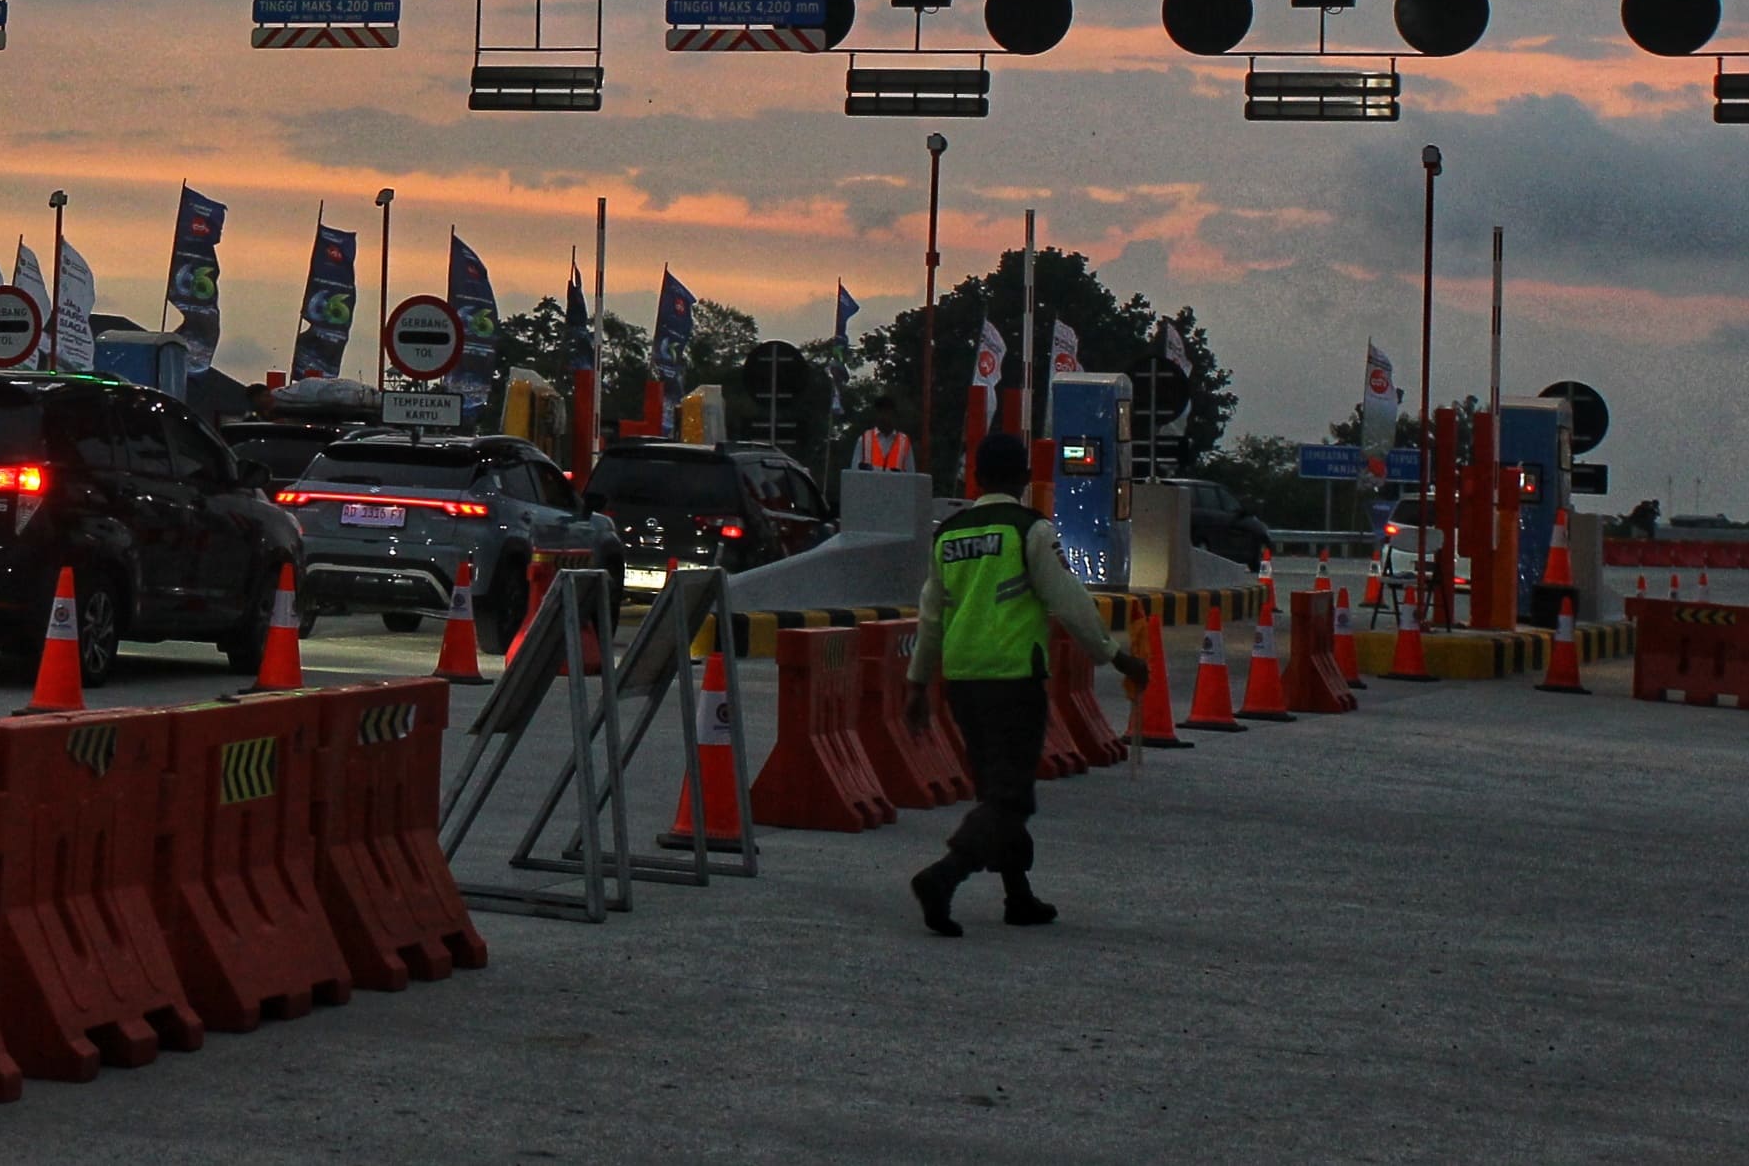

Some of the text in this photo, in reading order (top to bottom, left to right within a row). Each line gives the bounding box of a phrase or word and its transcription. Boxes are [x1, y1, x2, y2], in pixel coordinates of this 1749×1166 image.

[260, 0, 298, 12] TINGGI
[301, 1, 332, 13] MAKS
[673, 0, 714, 13] TINGGI
[718, 1, 751, 13] MAKS
[401, 317, 449, 329] GERBANG
[414, 347, 434, 359] TOL
[393, 396, 452, 409] TEMPELKAN
[405, 409, 439, 421] KARTU
